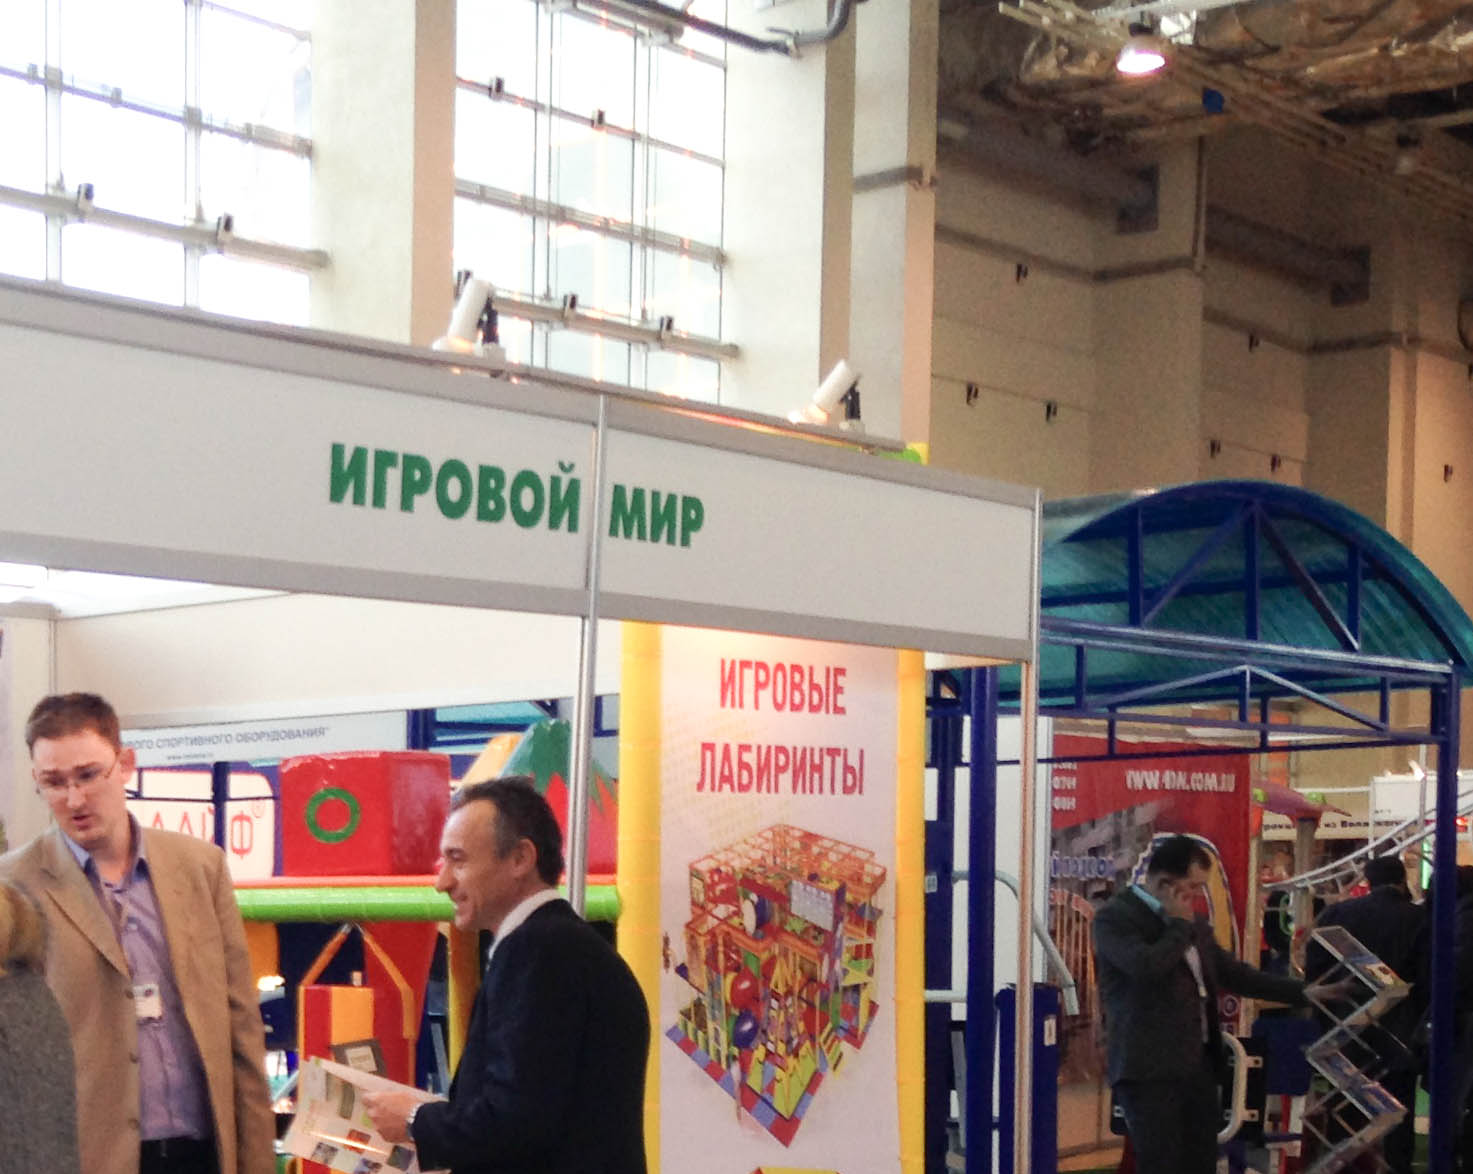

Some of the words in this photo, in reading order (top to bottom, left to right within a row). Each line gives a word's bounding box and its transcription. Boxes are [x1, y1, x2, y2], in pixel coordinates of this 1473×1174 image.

[329, 442, 582, 534] ИГРОВОЙ
[608, 484, 705, 548] МИР
[718, 658, 847, 716] ИГРОВЫЕ
[696, 742, 865, 796] ЛАБИРИНТЫ
